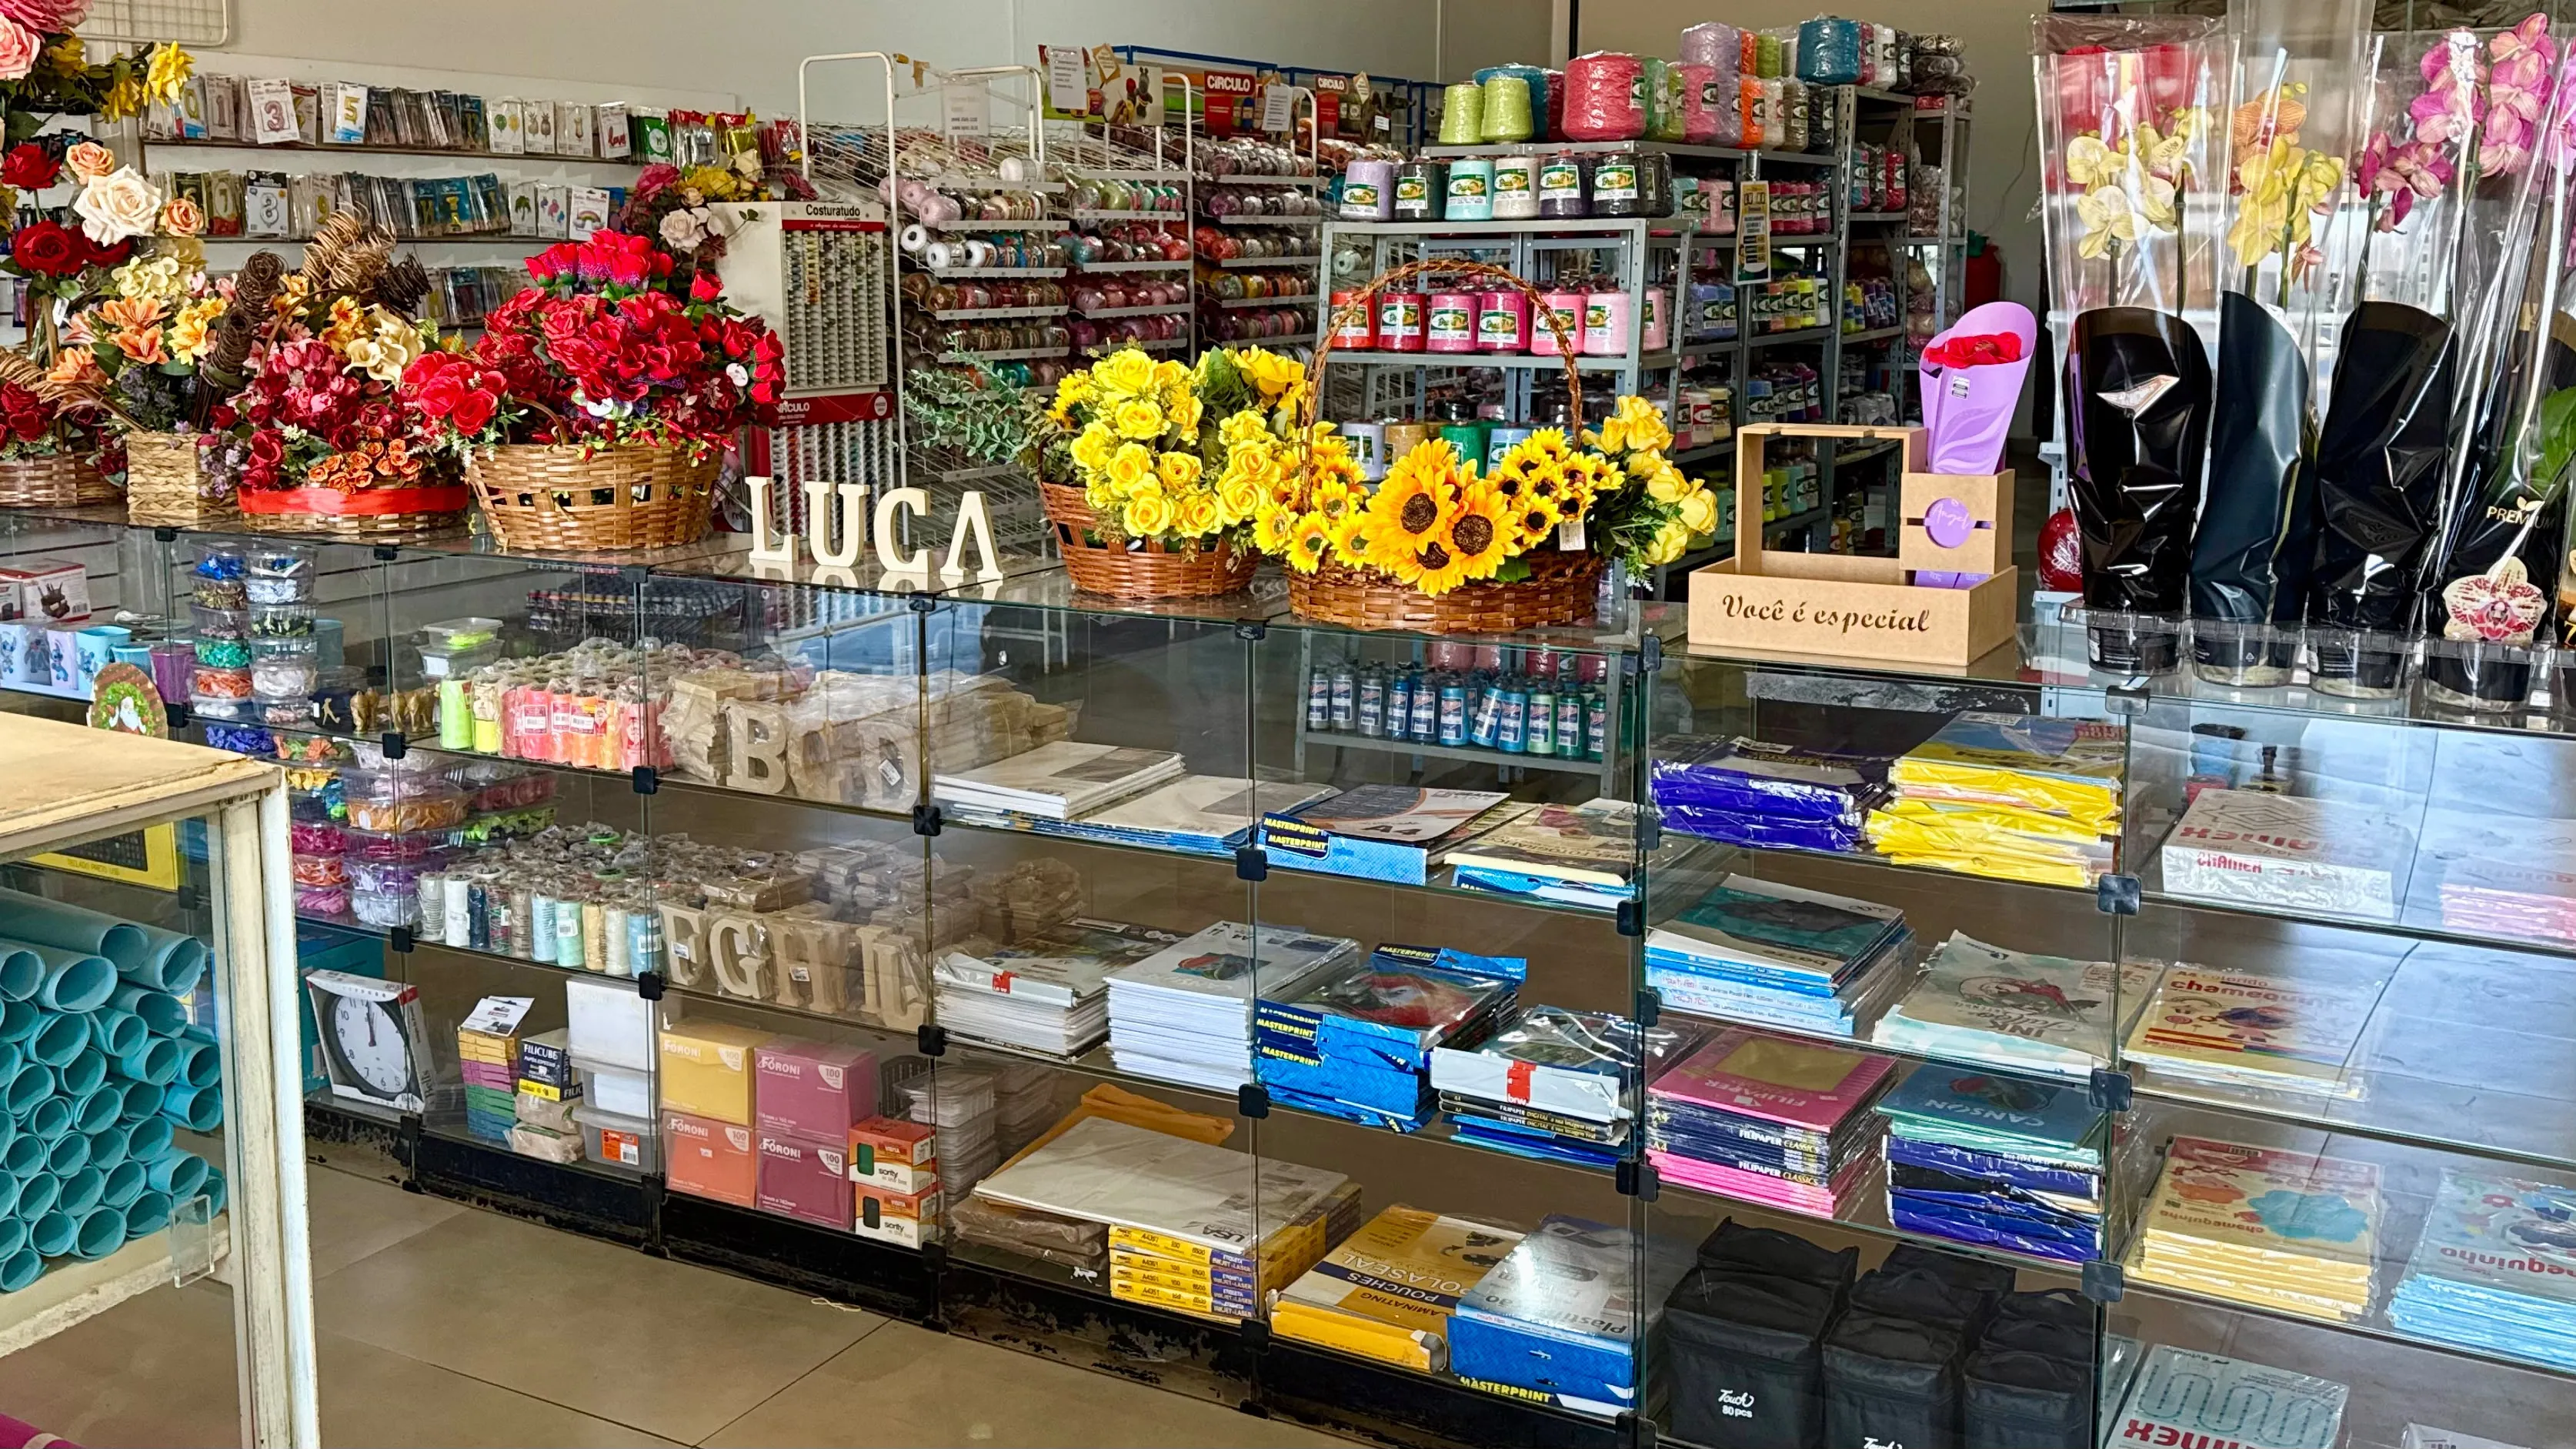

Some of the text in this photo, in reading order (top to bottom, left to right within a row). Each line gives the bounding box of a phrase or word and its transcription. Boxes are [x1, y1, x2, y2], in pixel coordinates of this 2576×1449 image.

[806, 204, 861, 216] Costuratudo
[746, 476, 1003, 580] LUCA
[1722, 594, 1931, 634] Você é especial
[1263, 817, 1321, 835] MASTERPRINT
[1268, 834, 1328, 850] MASTERPRINT
[1256, 1019, 1315, 1038] MASTERPRINT
[663, 1039, 702, 1058] FORONI
[1262, 1047, 1321, 1067] MASTERPRINT
[757, 1055, 801, 1076] FORONI
[825, 1067, 840, 1079] 100
[667, 1117, 709, 1137] FORONI
[1738, 1128, 1782, 1147] FILIPAPER
[759, 1137, 801, 1159] FORONI
[825, 1153, 840, 1165] 100
[1737, 1160, 1781, 1178] FILIPAPER
[1782, 1171, 1819, 1187] CLASSICS
[1346, 1272, 1440, 1303] POUCHES
[1460, 1375, 1552, 1403] MASTERPRINT
